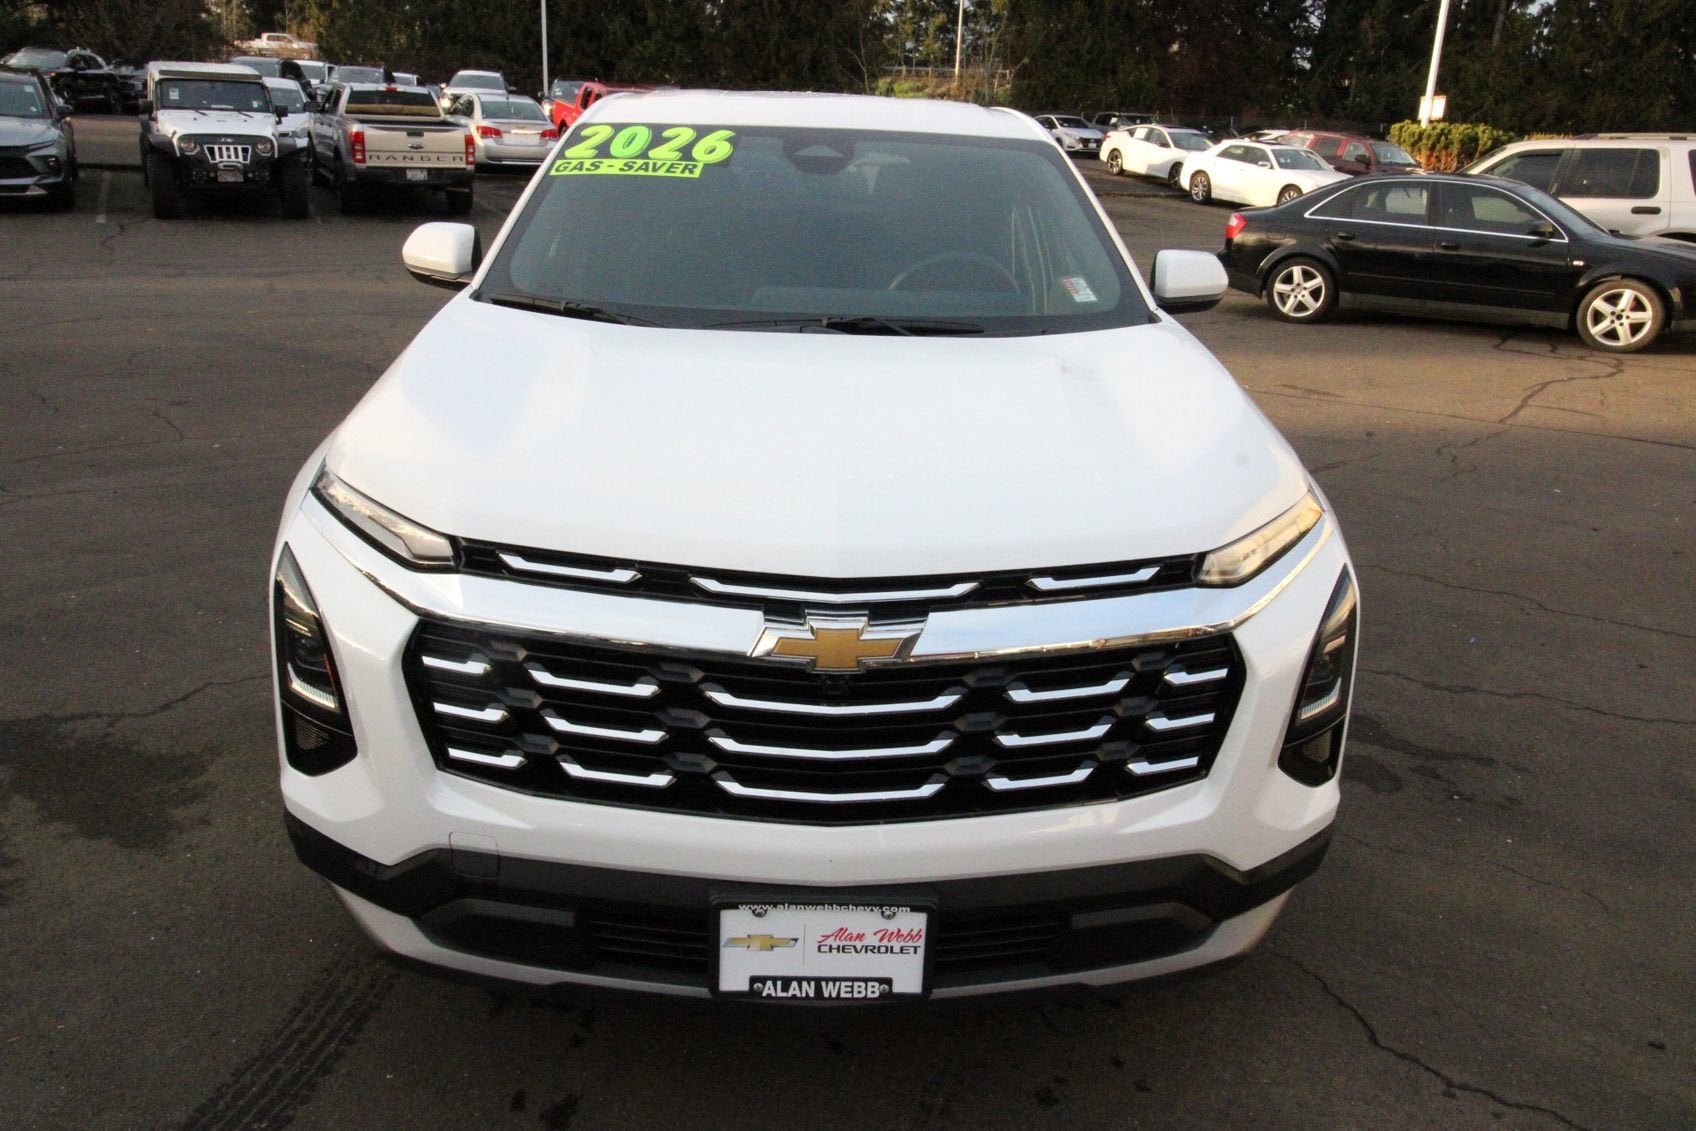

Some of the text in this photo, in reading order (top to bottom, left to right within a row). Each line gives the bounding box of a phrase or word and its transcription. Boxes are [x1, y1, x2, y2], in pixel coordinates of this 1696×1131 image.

[564, 124, 736, 164] 2026
[368, 154, 464, 163] RANGER
[738, 903, 911, 913] www.alanwebbchevy.com
[817, 927, 923, 944] Alan Webb
[817, 944, 921, 955] CHEVROLET
[762, 980, 880, 998] ALAN WEBB
